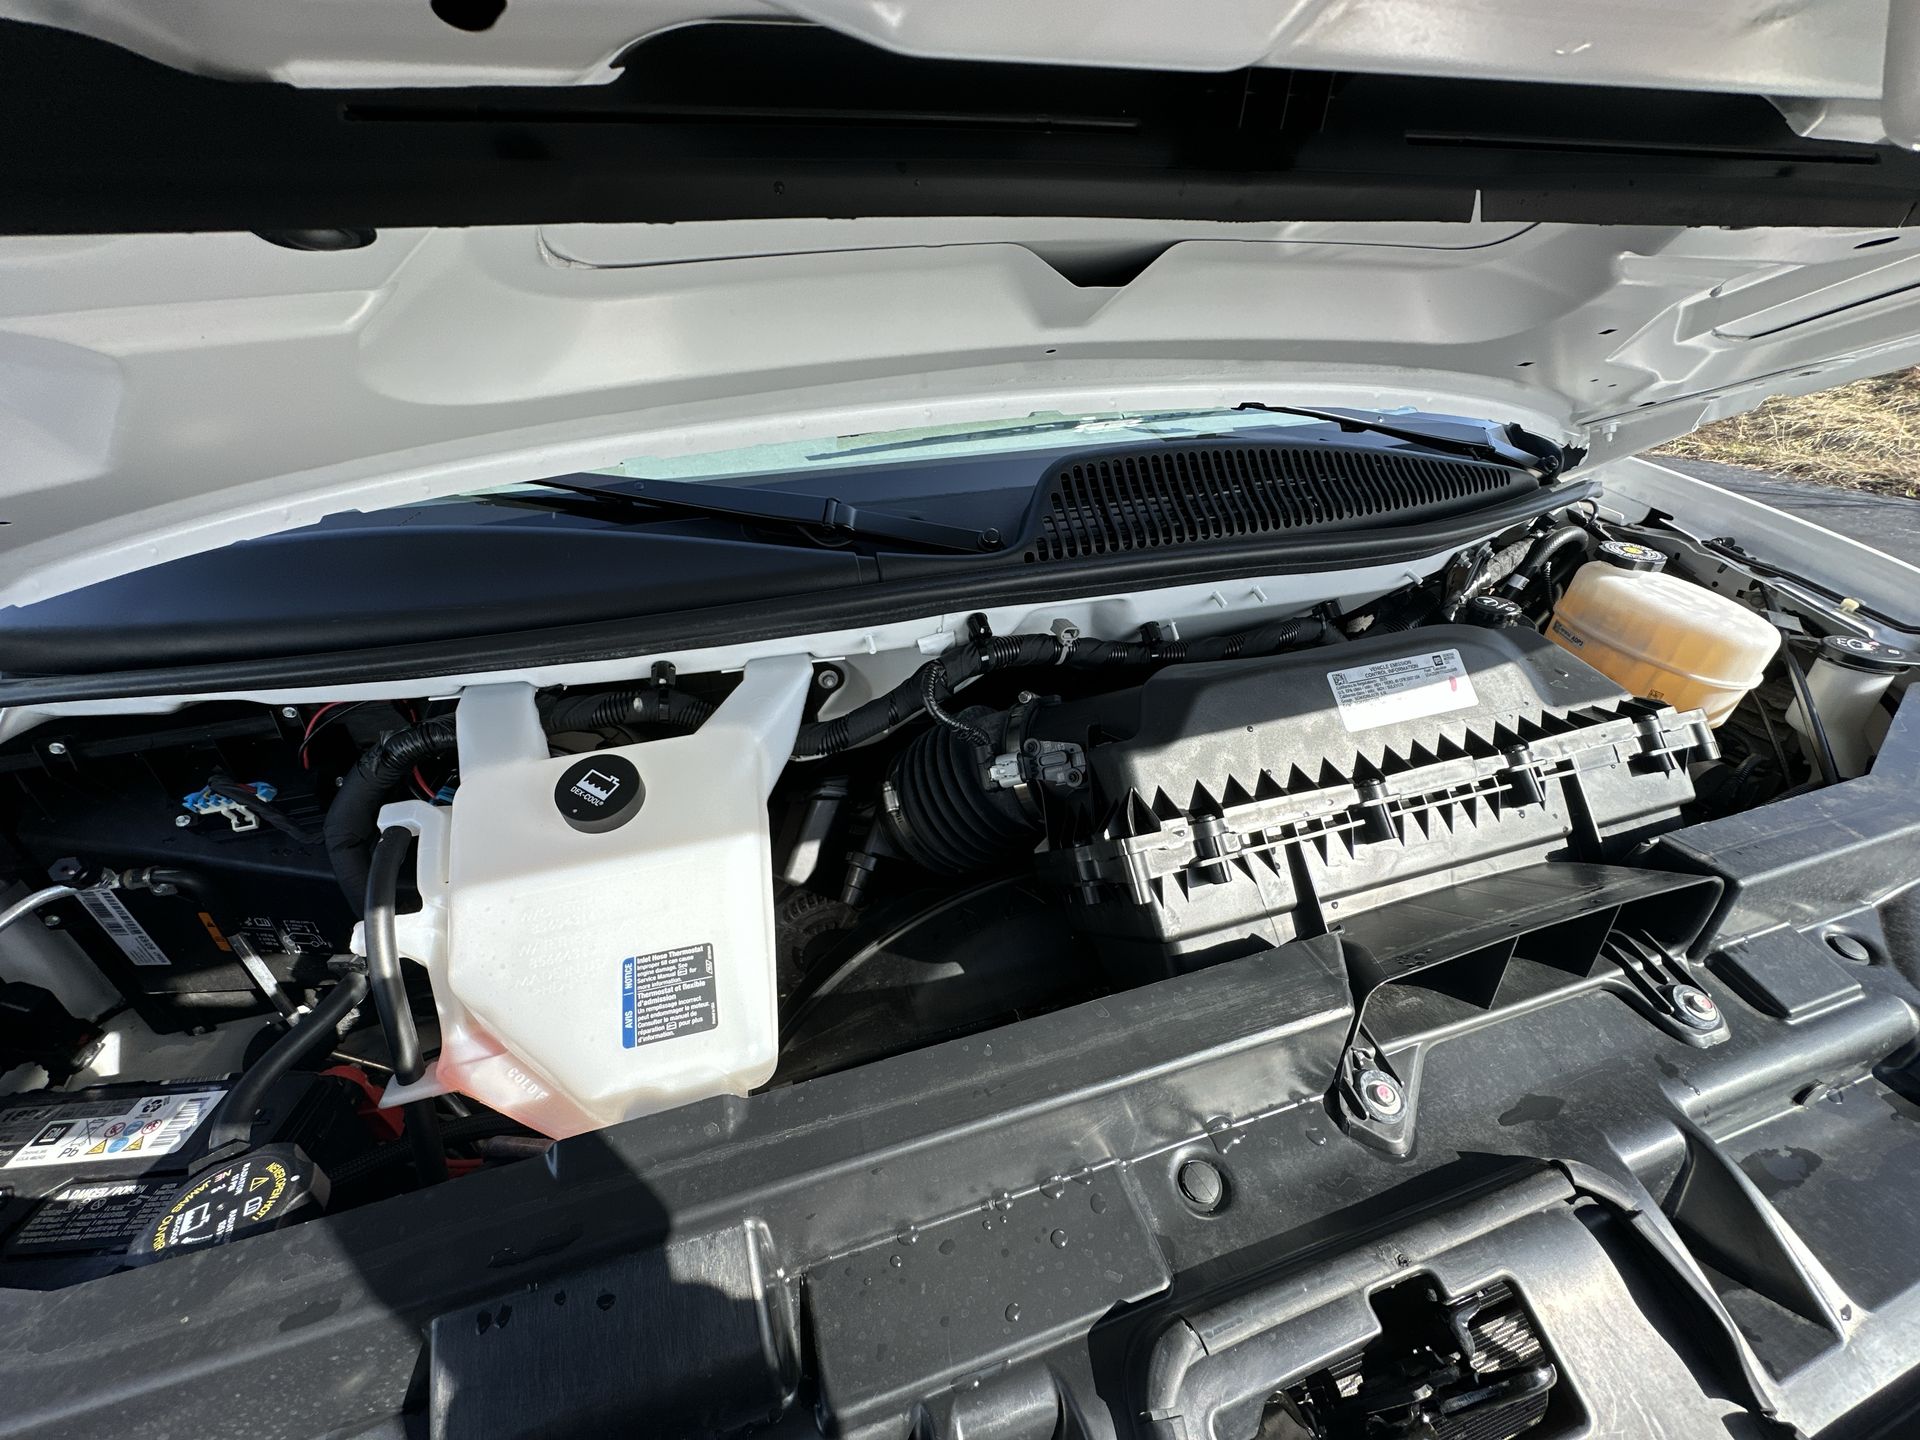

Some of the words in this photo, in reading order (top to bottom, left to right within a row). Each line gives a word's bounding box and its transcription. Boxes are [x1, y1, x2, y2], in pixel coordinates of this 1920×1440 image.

[1387, 663, 1419, 673] INFORMATION
[668, 946, 703, 957] Thermostat
[637, 987, 673, 998] Thermostat
[57, 1146, 79, 1158] Pb
[214, 1169, 232, 1183] NE
[171, 1180, 211, 1213] JAMAIS
[153, 1215, 173, 1251] OUVRIR
